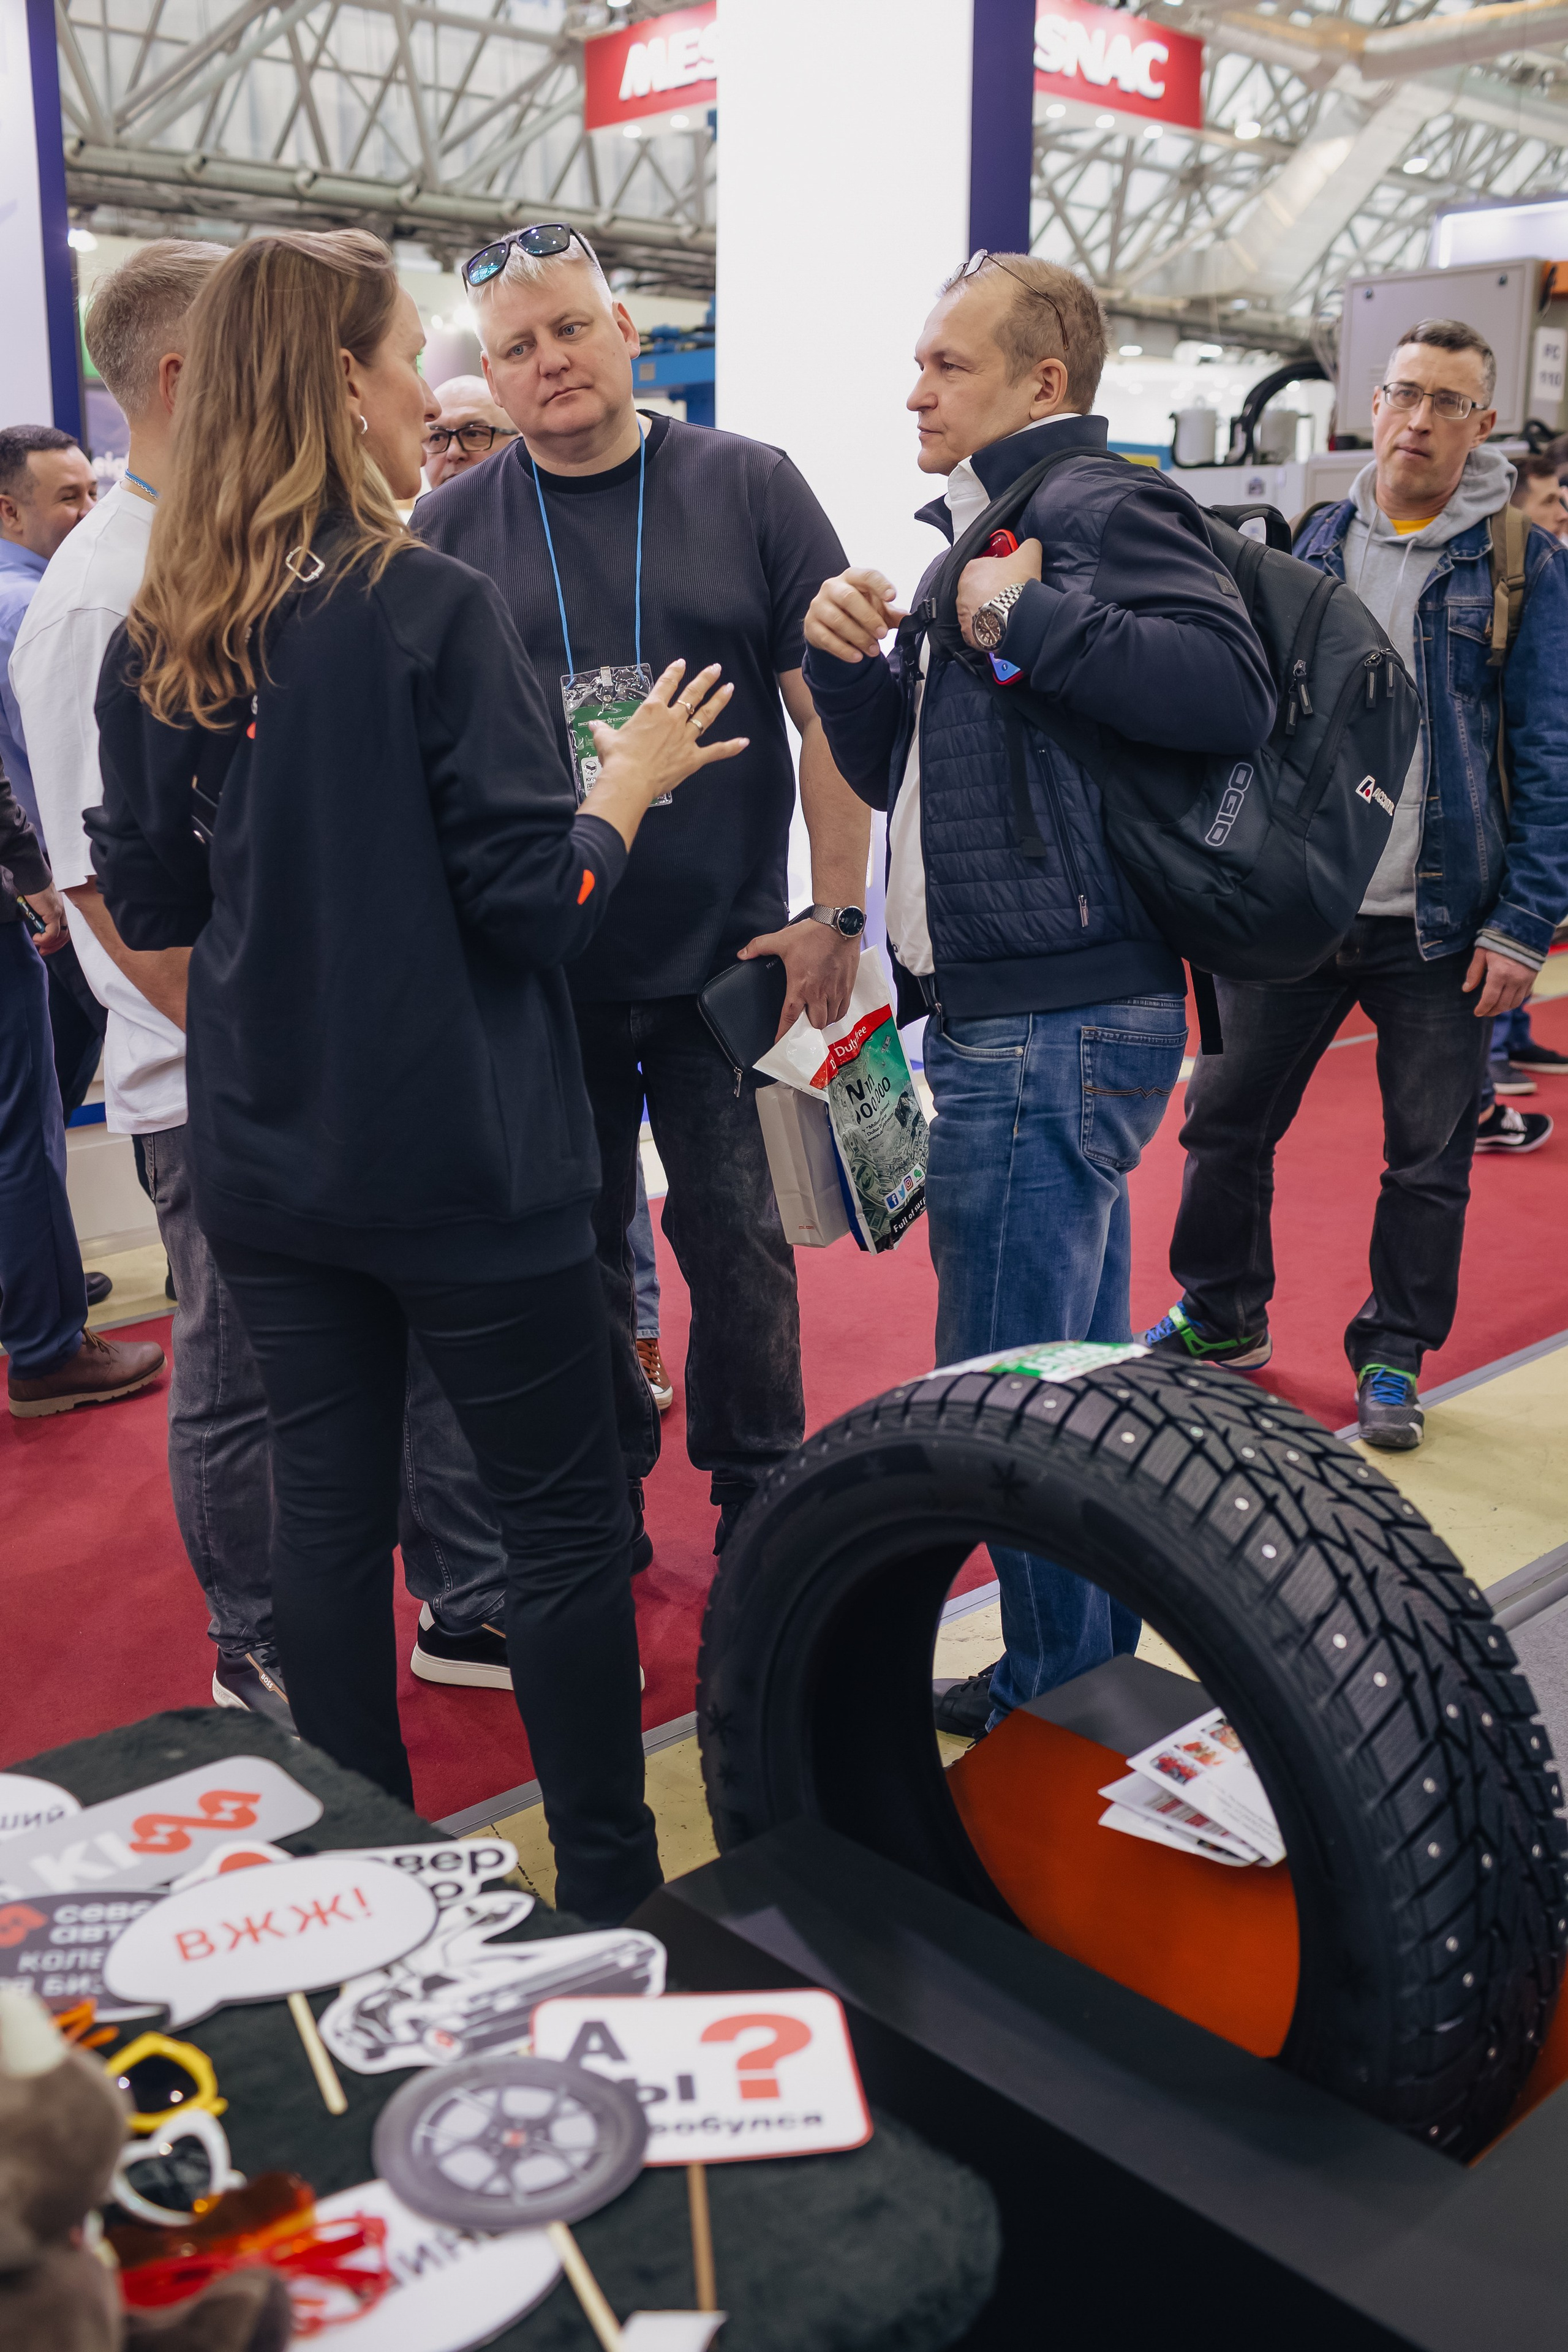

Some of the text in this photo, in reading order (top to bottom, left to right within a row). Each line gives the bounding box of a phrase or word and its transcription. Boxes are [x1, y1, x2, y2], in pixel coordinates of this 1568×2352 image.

[1032, 13, 1169, 100] SNAC
[1204, 762, 1254, 846] OGIO
[893, 1216, 908, 1233] Full
[908, 1208, 915, 1219] of
[174, 1887, 372, 1962] ВЖЖ!
